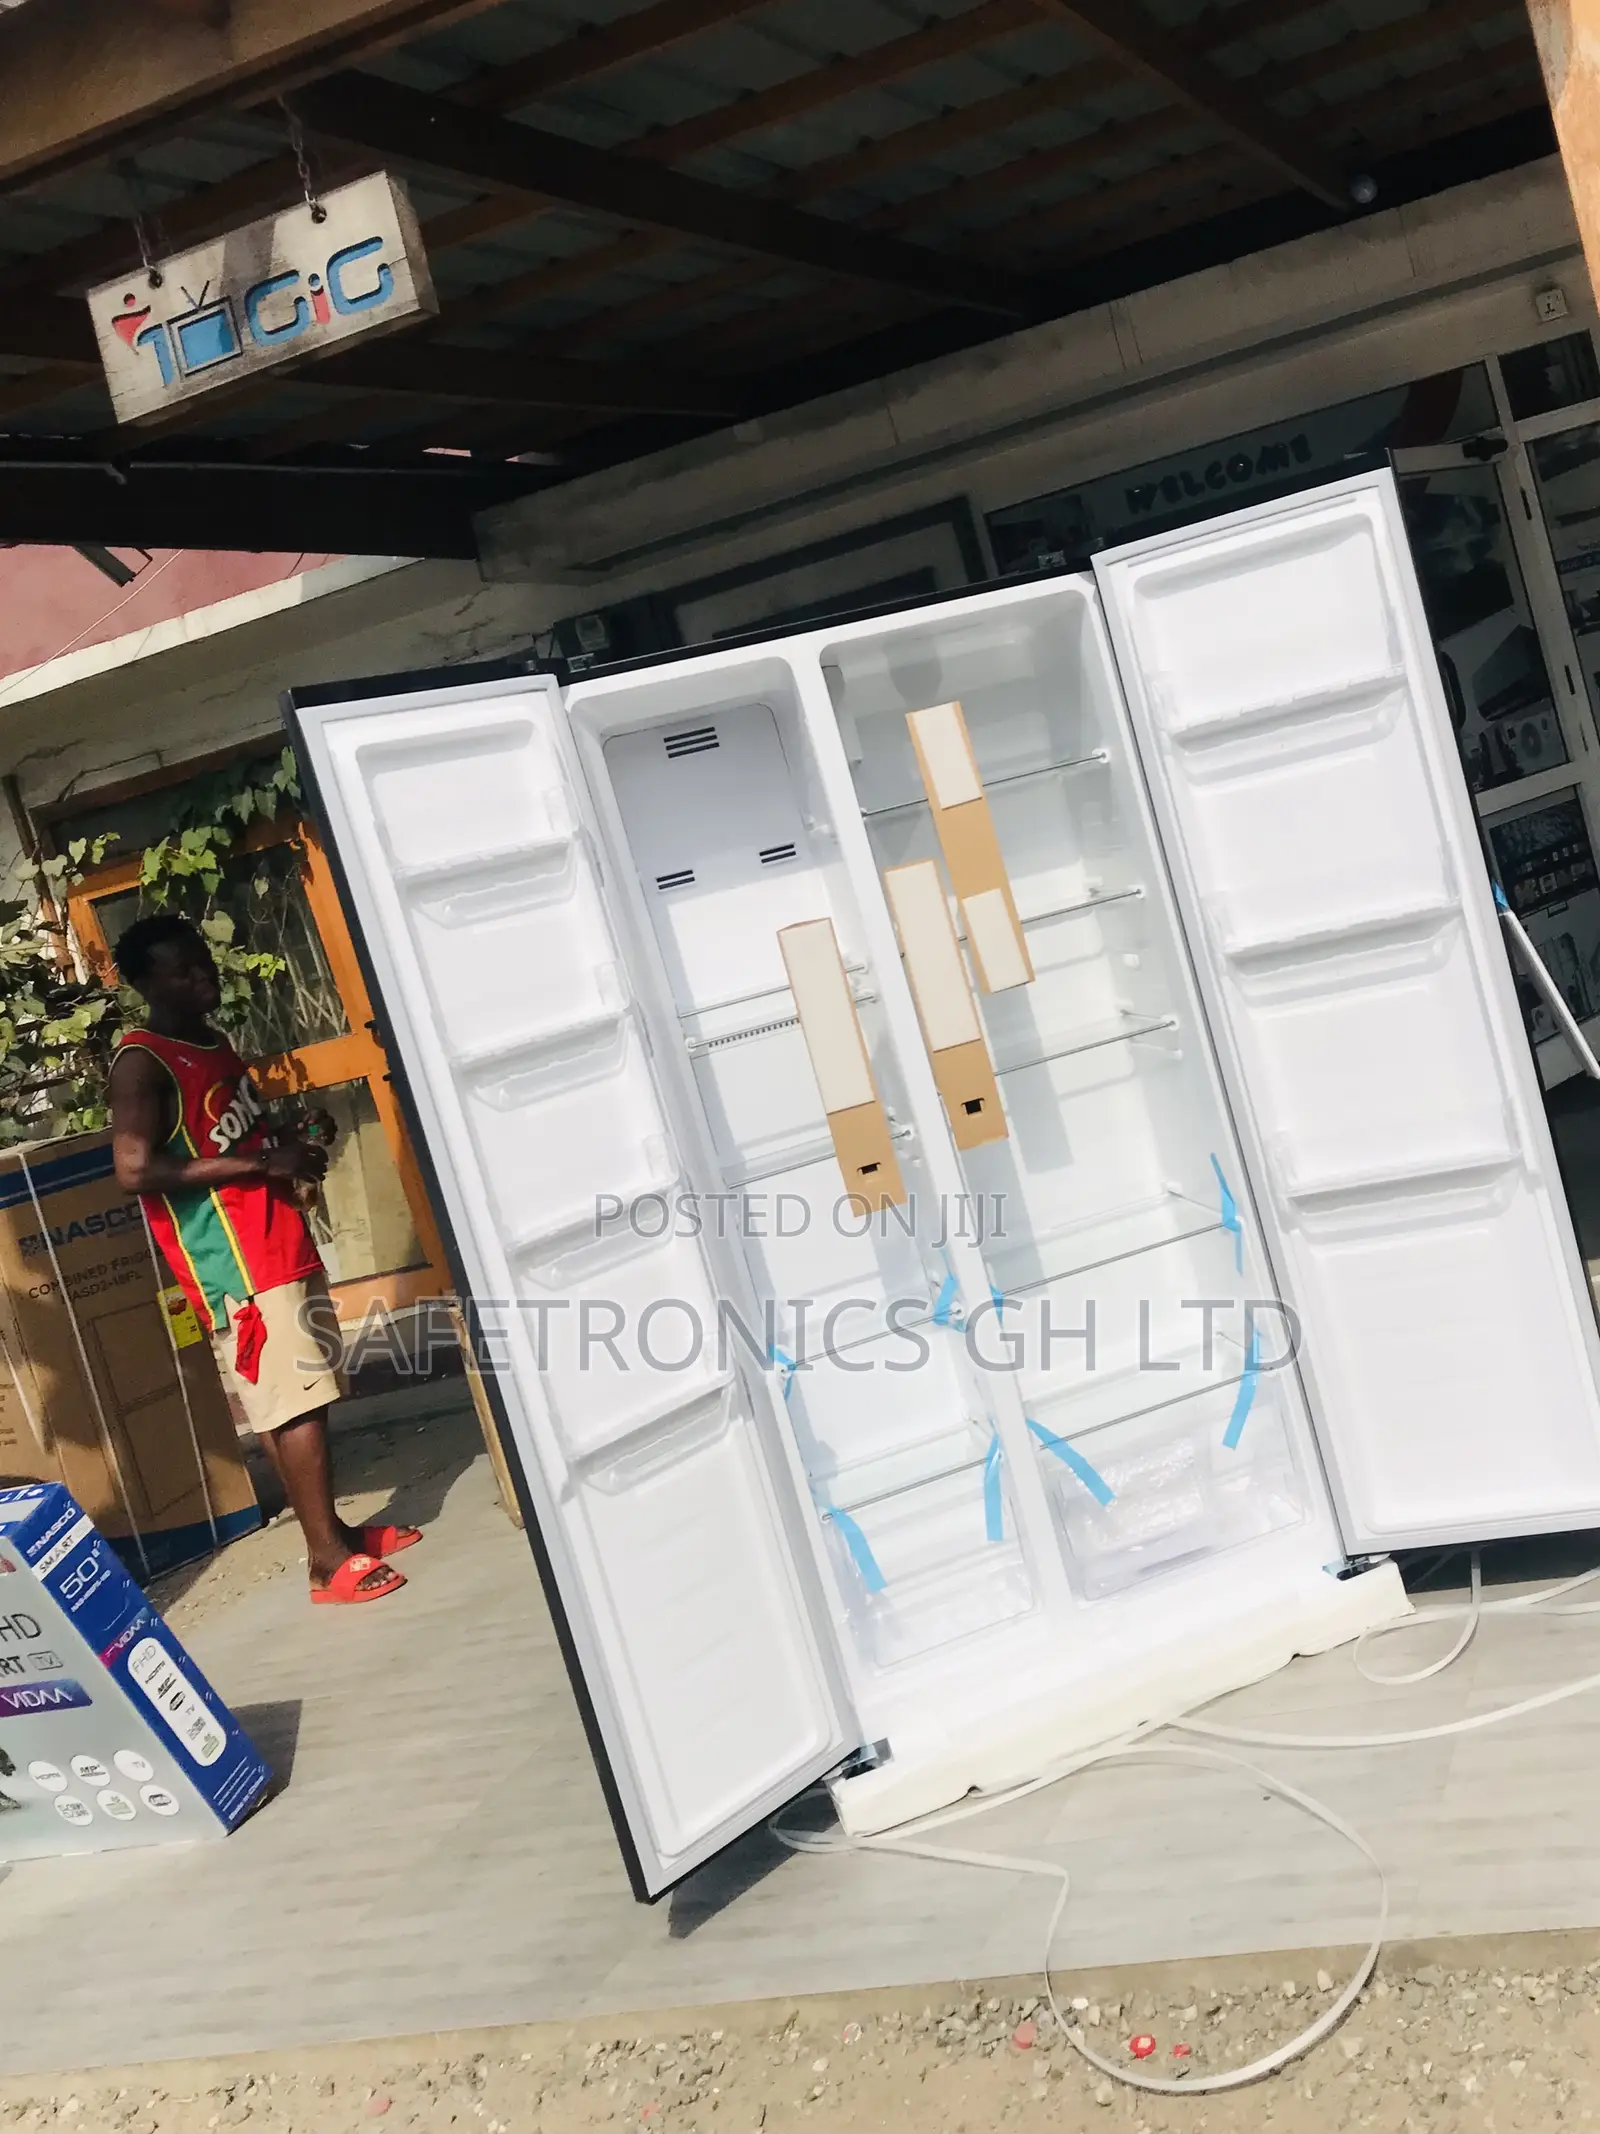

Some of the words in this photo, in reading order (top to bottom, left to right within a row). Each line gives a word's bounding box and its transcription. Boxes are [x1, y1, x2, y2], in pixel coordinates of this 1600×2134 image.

[1123, 433, 1313, 516] WELCOME
[40, 1202, 144, 1251] NASCO
[33, 1507, 76, 1552] NASCO
[40, 1534, 74, 1574] SMART
[0, 1655, 26, 1678] RT
